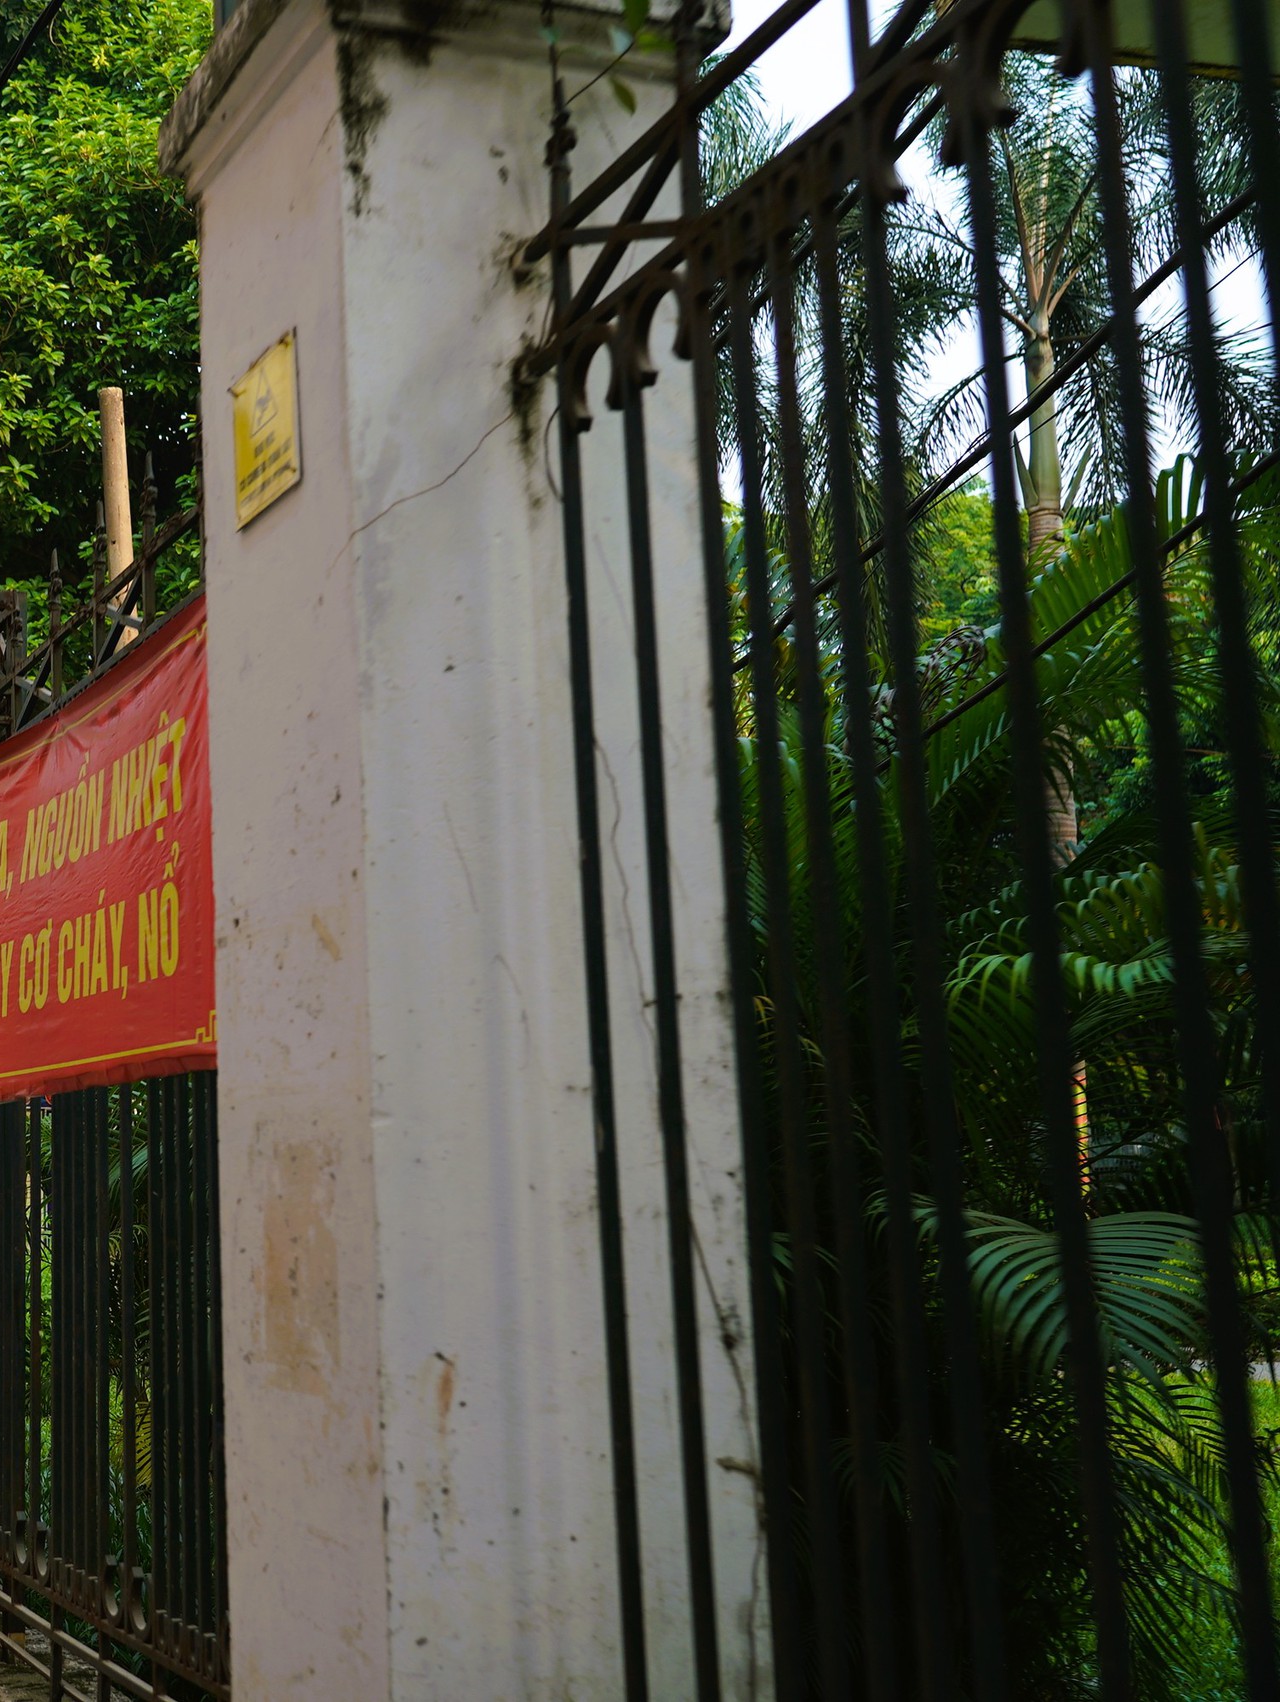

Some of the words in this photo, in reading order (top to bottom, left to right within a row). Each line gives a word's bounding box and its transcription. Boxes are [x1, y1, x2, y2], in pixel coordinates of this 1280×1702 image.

[19, 750, 105, 885] NGUỒN
[107, 709, 187, 846] NHIỆT
[18, 918, 53, 1014] CƠ
[57, 887, 129, 1004] CHÁY,
[137, 840, 180, 984] NỔ
